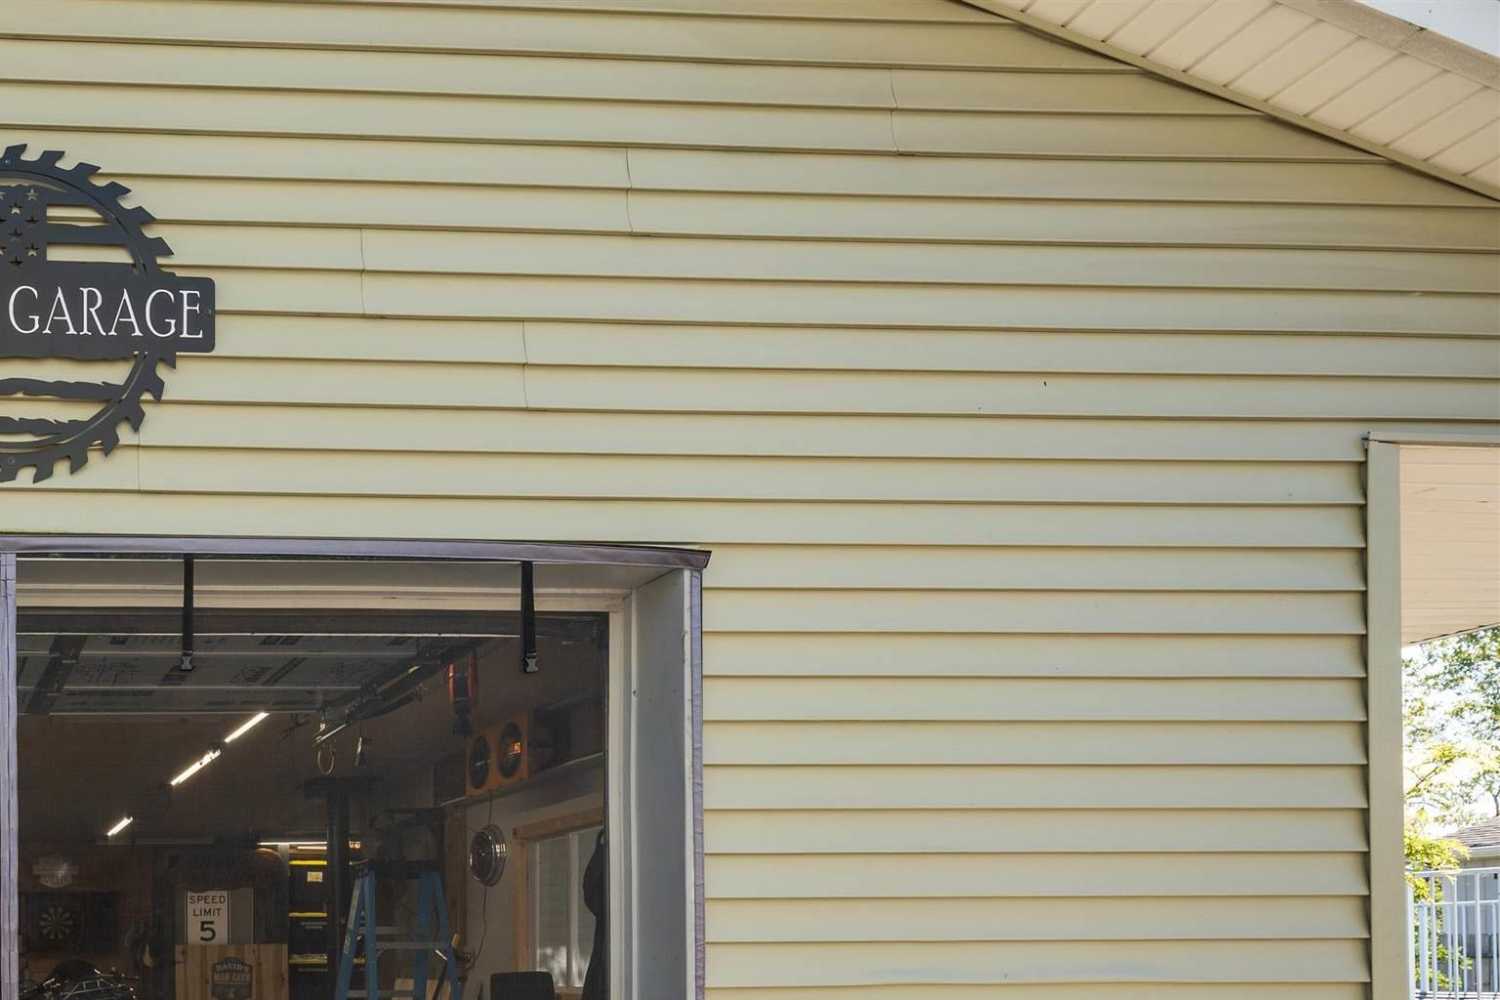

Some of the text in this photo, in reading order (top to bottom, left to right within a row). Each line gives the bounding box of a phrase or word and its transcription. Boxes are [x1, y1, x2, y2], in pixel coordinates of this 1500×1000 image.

[7, 285, 204, 339] GARAGE
[189, 895, 226, 904] SPEED
[193, 908, 222, 917] LIMIT
[200, 920, 216, 942] 5
